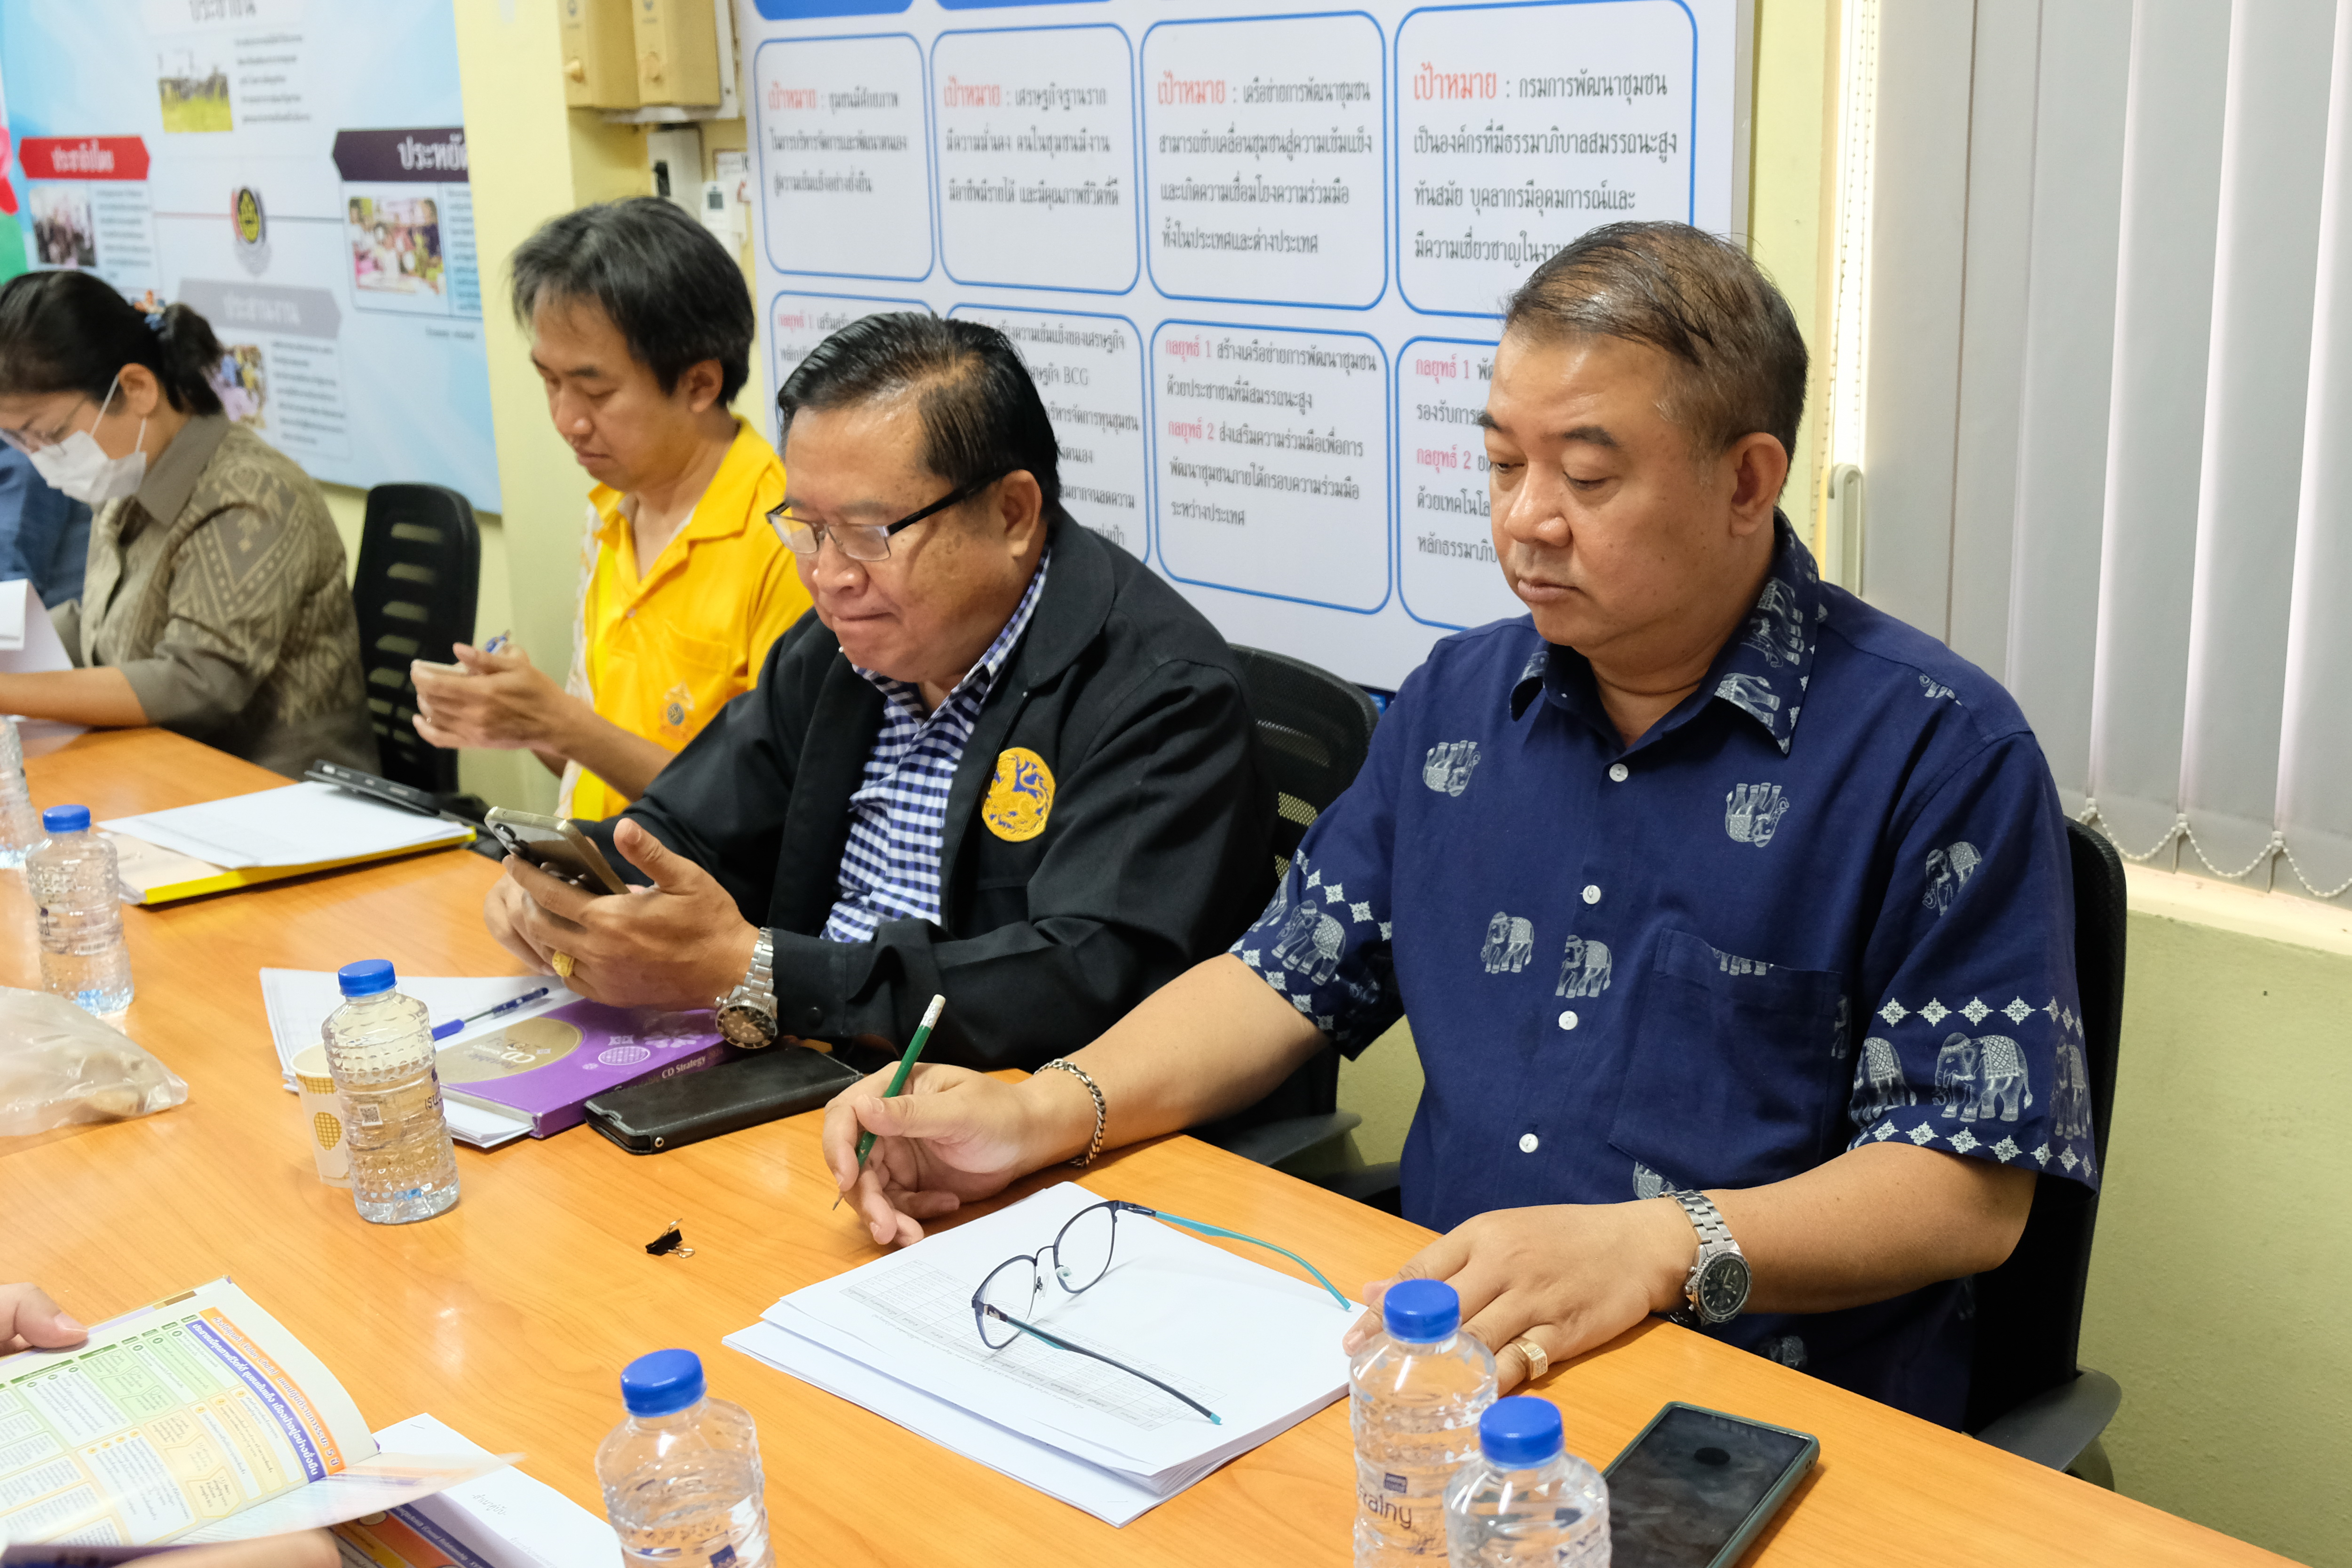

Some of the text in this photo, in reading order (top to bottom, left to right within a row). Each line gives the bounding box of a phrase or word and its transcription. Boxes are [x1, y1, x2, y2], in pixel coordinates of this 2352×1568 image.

[944, 75, 1001, 107] เป้าหมาย
[1015, 81, 1107, 111] เศรษฐกิจฐานราก
[1158, 70, 1225, 104] เป้าหมาย
[1243, 76, 1371, 109] เครือข่ายการพัฒนาชุมชน
[1414, 62, 1497, 99] เป้าหมาย
[1519, 68, 1668, 105] กรมการพัฒนาชุมชน
[946, 122, 1111, 159] มีความมั่นคง คนในชุมชนมีงาน
[1159, 121, 1372, 161] สามารถขับเคลื่อนชุมชนสู่ความเข้มแข็ง
[1414, 119, 1677, 163] เป็นองค์กรที่มีธรรมาภิบาลสมรรถนะสูง
[1160, 171, 1349, 204] และเกิดความเชื่อมโยงความร่วมมือ
[1414, 179, 1636, 216] ทันสมัย บุคลากรมีอุดมการณ์และ
[1162, 216, 1318, 253] ทั้งในประเทศและต่างประเทศ
[1165, 335, 1377, 375] กลยุทธ์ 1 สร้างเครือข่ายการพัฒนาชุมชน
[1416, 353, 1457, 384] กลยุทธ์
[1463, 359, 1469, 379] 1
[1064, 366, 1089, 385] BCG
[1167, 374, 1312, 415] ด้วยประชาชนที่มีสมรรถนะสูง
[1416, 399, 1482, 425] รองรับการ
[1168, 417, 1363, 457] กลยุทธ์ 2 ส่งเสริมความร่วมมือเพื่อการ
[1417, 444, 1457, 473] กลยุทธ์
[1463, 450, 1471, 470] 2
[1169, 455, 1359, 500] พัฒนาชุมชนภายใต้กรอบความร่วมมือ
[1171, 499, 1245, 525] ระหว่างประเทศ
[661, 1055, 706, 1079] CD Strategy
[240, 1342, 259, 1358] (Value
[258, 1358, 279, 1375] Chain)
